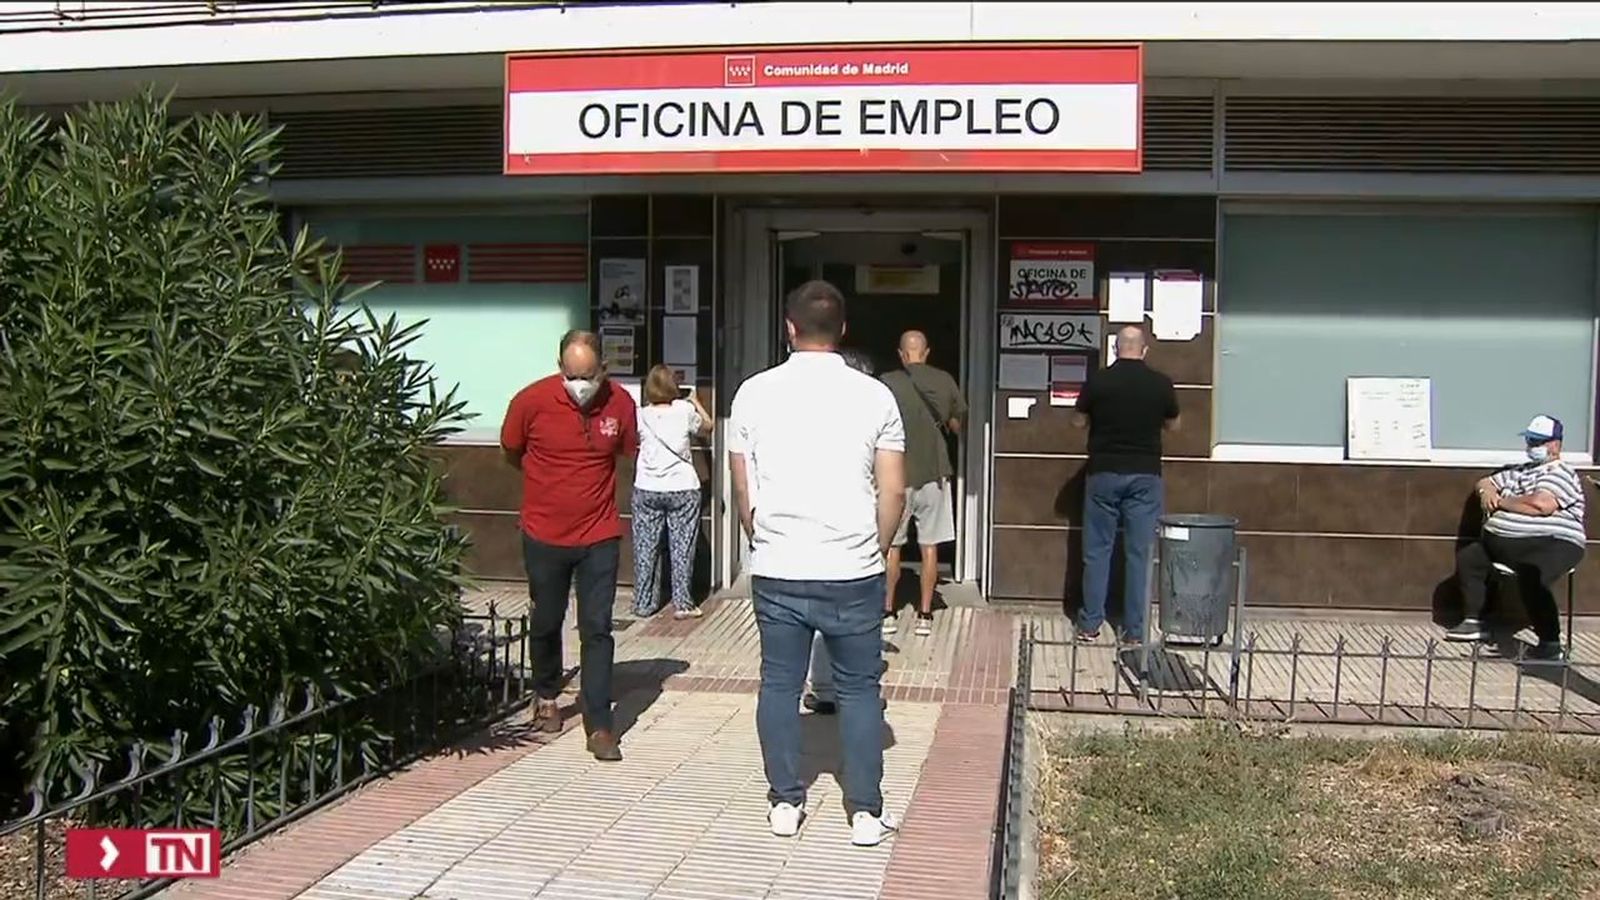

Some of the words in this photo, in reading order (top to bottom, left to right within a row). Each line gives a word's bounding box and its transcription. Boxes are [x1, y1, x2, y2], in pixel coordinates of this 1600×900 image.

[763, 63, 838, 76] Comunidad
[842, 63, 858, 75] de
[862, 62, 909, 75] Madrid
[578, 101, 764, 139] OFICINA
[780, 101, 842, 136] DE
[859, 98, 1061, 136] EMPLEO
[1017, 268, 1067, 280] OFICINA
[1070, 268, 1087, 279] DE
